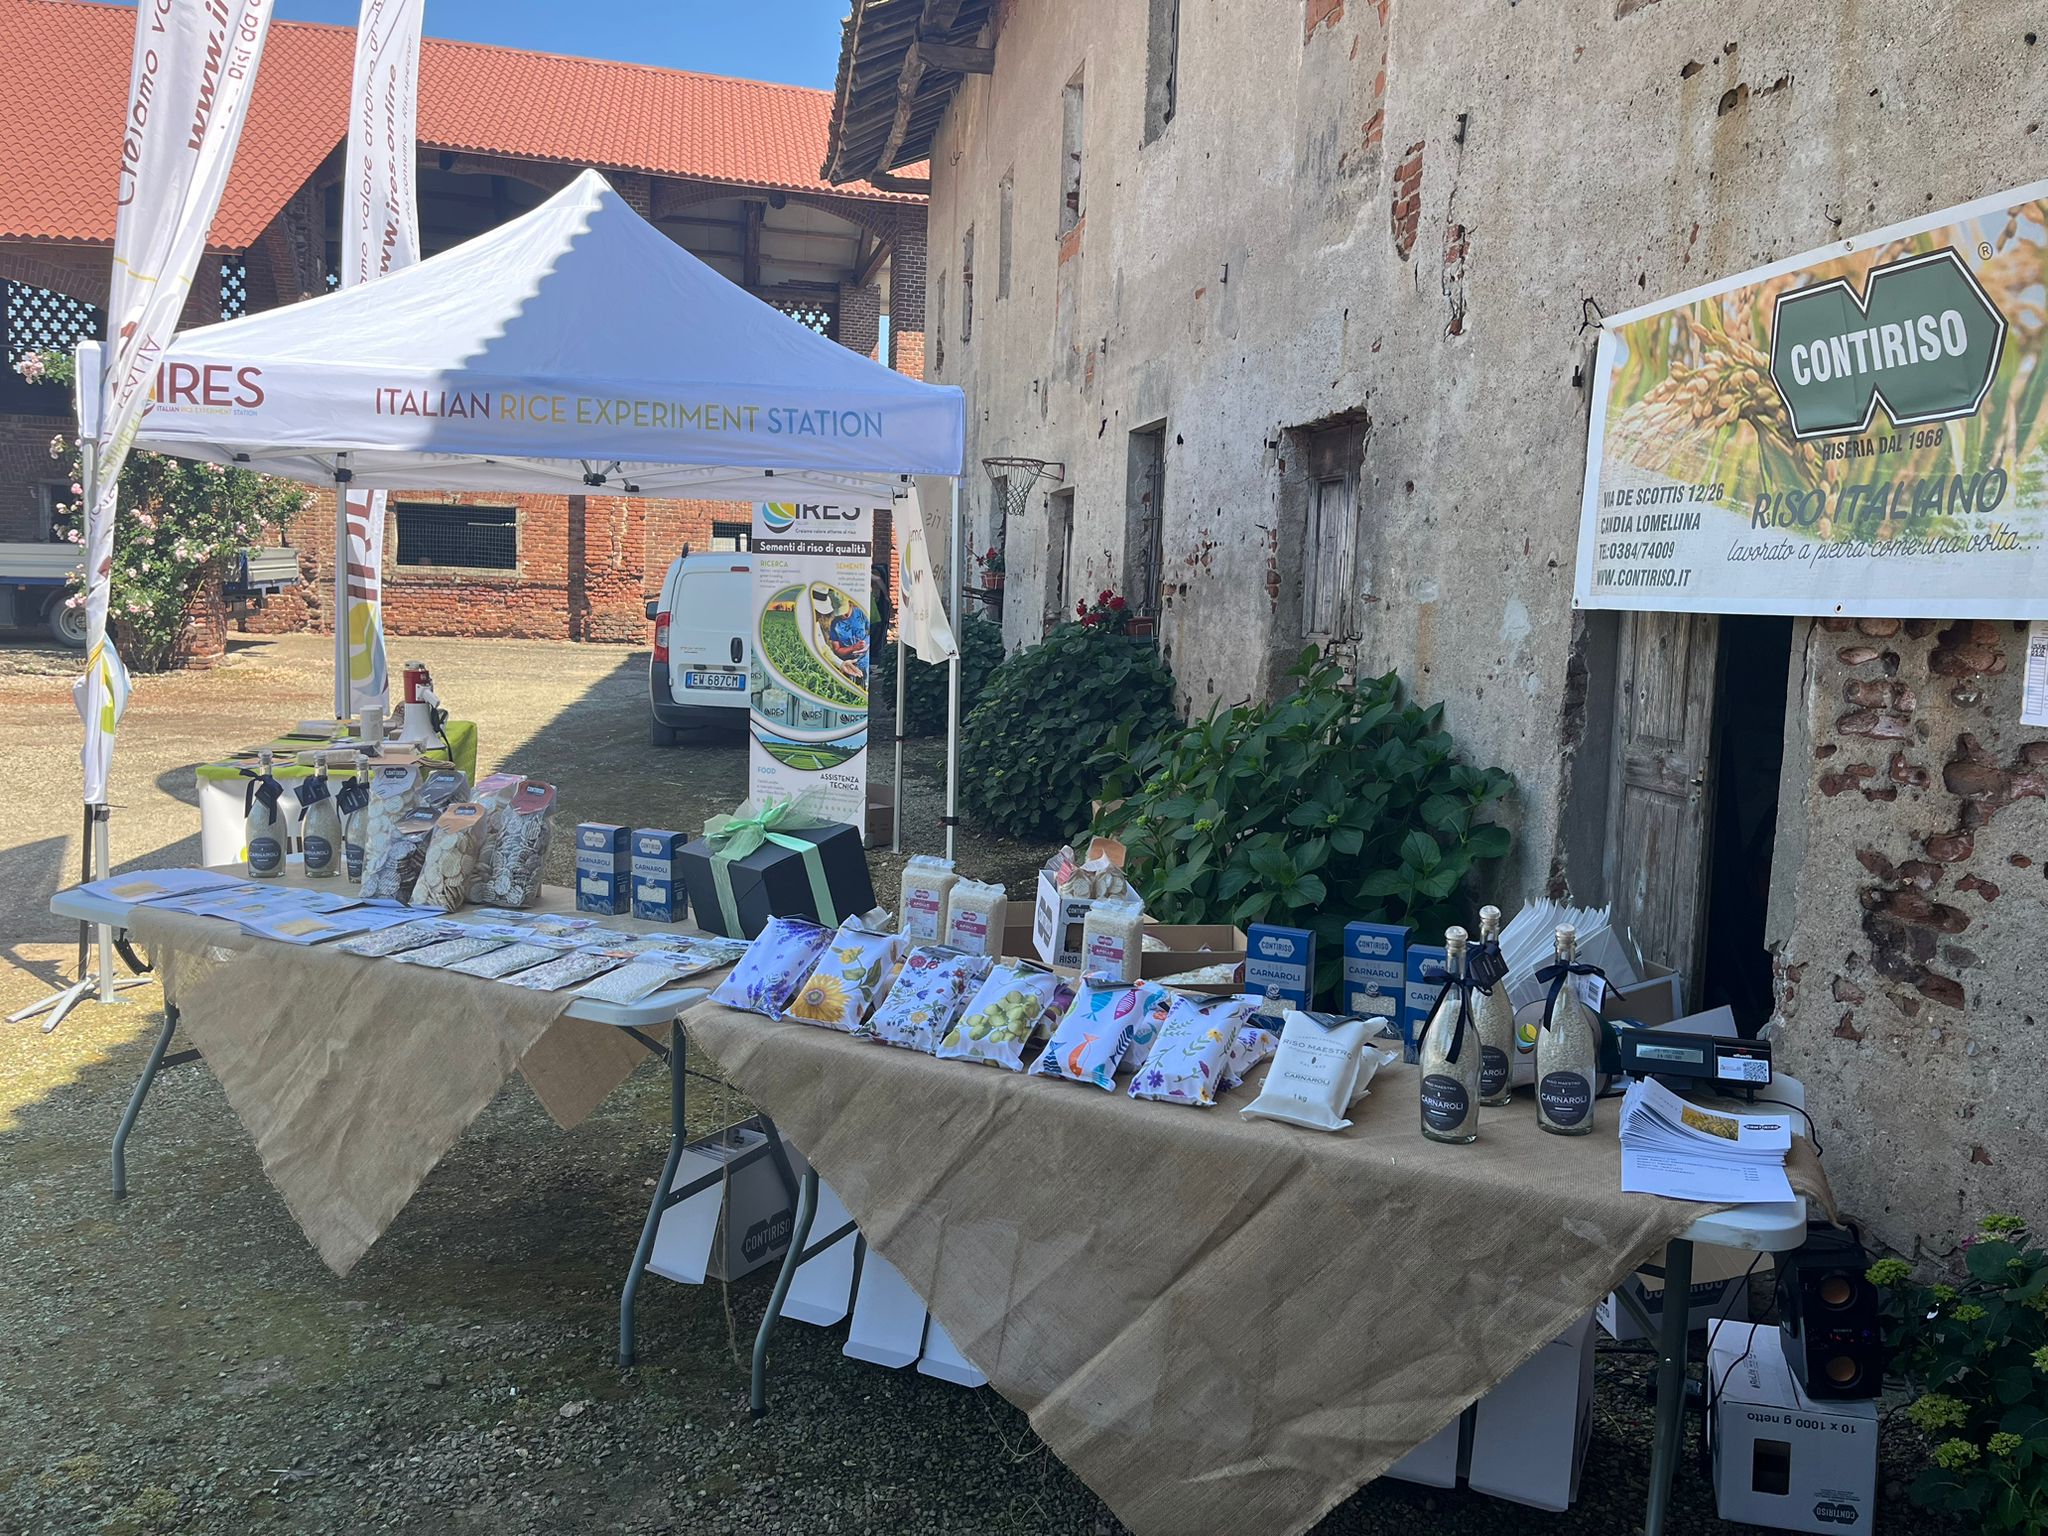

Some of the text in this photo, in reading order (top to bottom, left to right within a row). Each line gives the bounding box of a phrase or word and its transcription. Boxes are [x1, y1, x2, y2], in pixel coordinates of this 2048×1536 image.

[359, 155, 373, 231] valore
[1790, 309, 1968, 386] CONTIRISO
[156, 361, 265, 408] IRES
[156, 405, 180, 413] ITALIAN
[376, 387, 883, 438] ITALIAN RICE EXPERIMENT STATION
[1822, 427, 1943, 461] RISERIA DAL 1968
[1603, 483, 1725, 509] VIA DE SCOTTIS 12/26
[1751, 467, 2008, 530] RISO ITALIANO
[1636, 512, 1701, 532] LOMELLINA
[760, 541, 867, 555] Sementi di riso di qualità
[1727, 522, 2040, 569] lavorato a pietra come una volta...
[760, 560, 789, 568] RICERCA
[707, 675, 739, 687] 687CM
[757, 766, 776, 775] FOOD
[820, 773, 860, 784] ASSISTENZA
[829, 781, 860, 791] TECNICA
[578, 856, 611, 867] CARNAROLI
[634, 863, 668, 874] CARNAROLI
[1261, 941, 1292, 952] CONTIRISO
[1358, 941, 1389, 951] CONTIRISO
[1250, 968, 1301, 981] CARNAROLI
[1348, 966, 1399, 979] CARNAROLI
[1282, 1038, 1306, 1048] RISO
[1306, 1044, 1353, 1060] MAESTRO
[1284, 1072, 1330, 1086] CARNAROLI
[1298, 1093, 1308, 1102] kg
[1421, 1094, 1464, 1111] CARNAROLI
[1541, 1092, 1588, 1104] CARNAROLI
[745, 1218, 791, 1253] CONTIRISO
[1747, 1412, 1857, 1434] 10 x 1000 g netto
[1816, 1507, 1856, 1520] CONTIRISO
